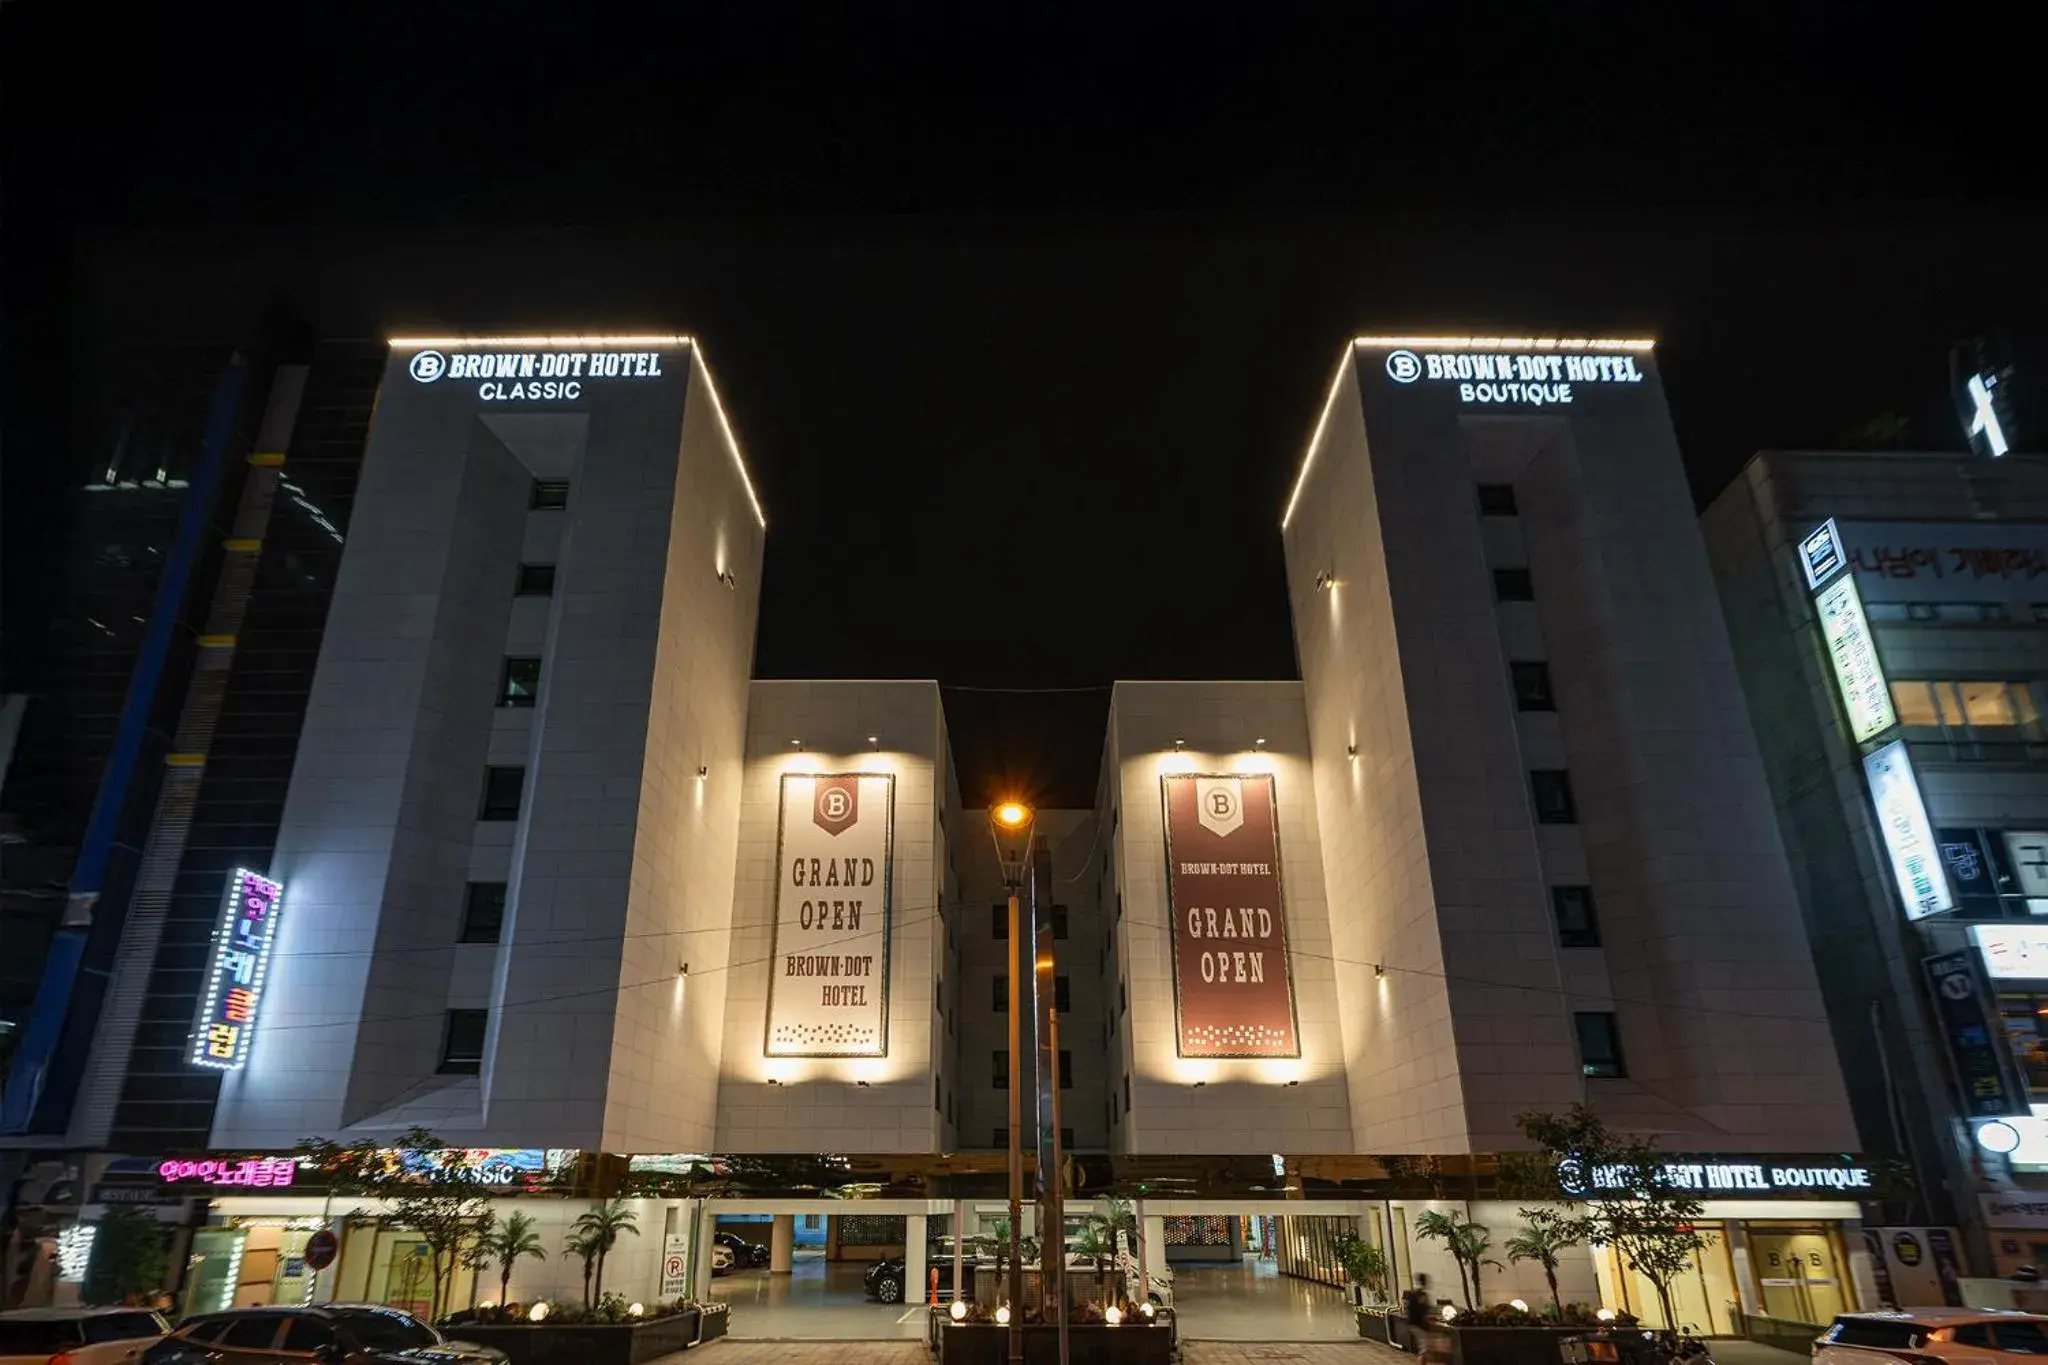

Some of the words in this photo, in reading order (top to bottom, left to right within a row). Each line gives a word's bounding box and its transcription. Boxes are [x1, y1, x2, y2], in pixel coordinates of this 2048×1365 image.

[588, 352, 661, 377] HOTEL
[1567, 356, 1643, 382] HOTEL
[478, 381, 580, 400] CLASSIC
[1460, 383, 1573, 405] BOUTIQUE
[827, 794, 845, 815] B
[1212, 794, 1230, 814] B
[792, 858, 874, 886] GRAND
[1240, 863, 1271, 875] HOTEL
[800, 901, 862, 930] OPEN
[1188, 908, 1272, 938] GRAND
[1201, 952, 1264, 983] OPEN
[822, 985, 867, 1006] HOTEL
[1706, 1165, 1770, 1189] HOTEL
[1771, 1167, 1870, 1190] BOUTIQUE
